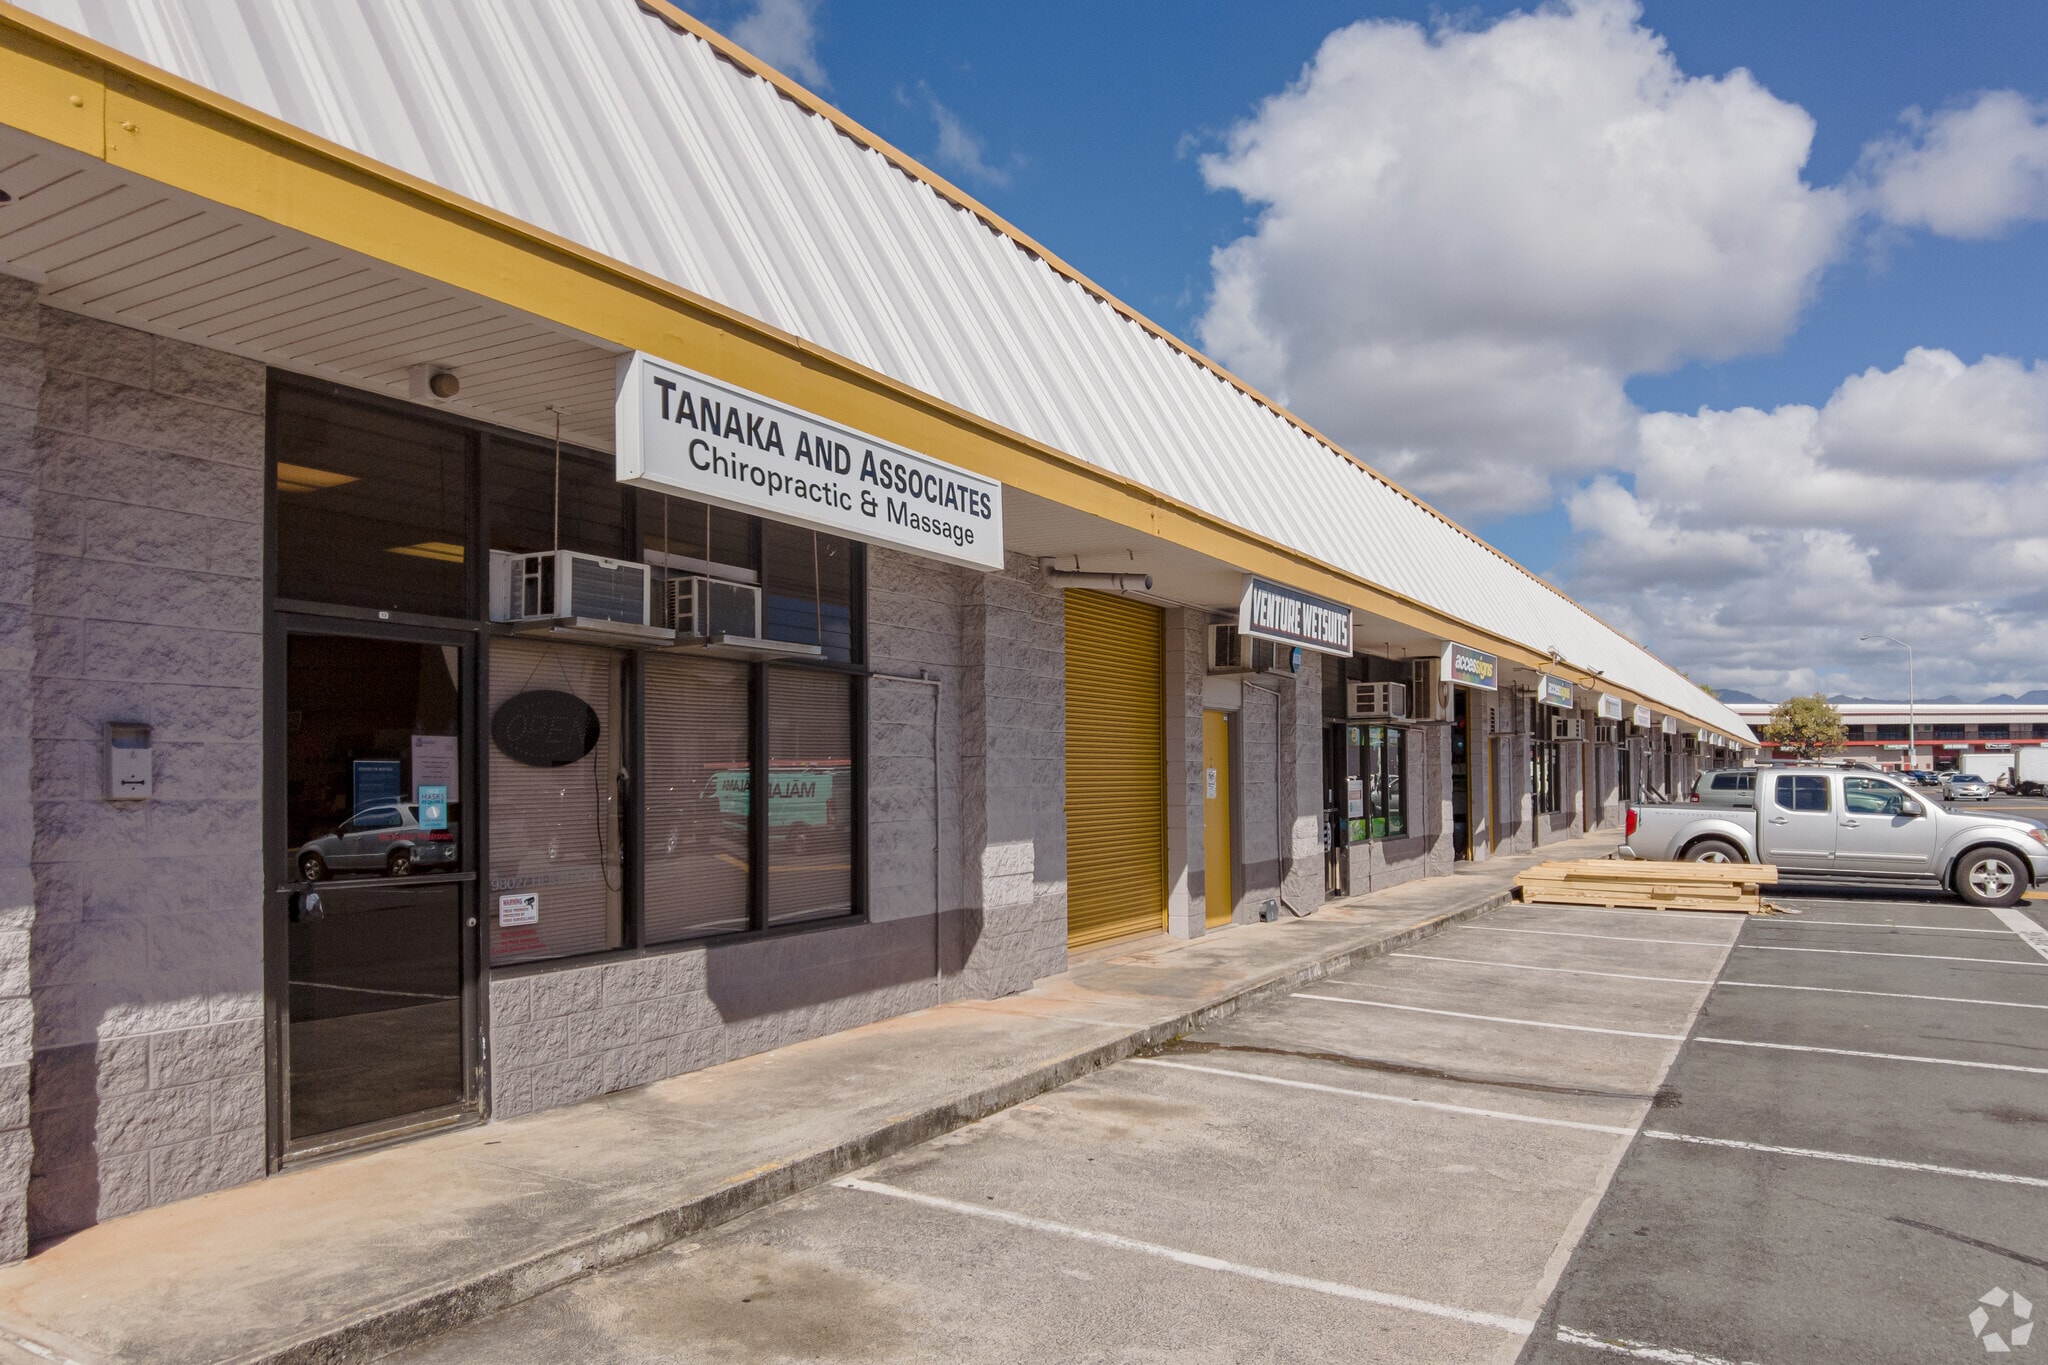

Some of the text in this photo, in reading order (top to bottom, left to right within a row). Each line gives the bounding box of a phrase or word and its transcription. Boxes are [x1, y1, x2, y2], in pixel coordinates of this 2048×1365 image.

[653, 376, 992, 520] TANAKA AND ASSOCIATES
[688, 438, 975, 547] Chiropractic & Massage
[1253, 588, 1348, 646] VENTURE WETSUITS
[1455, 653, 1493, 680] accessigns
